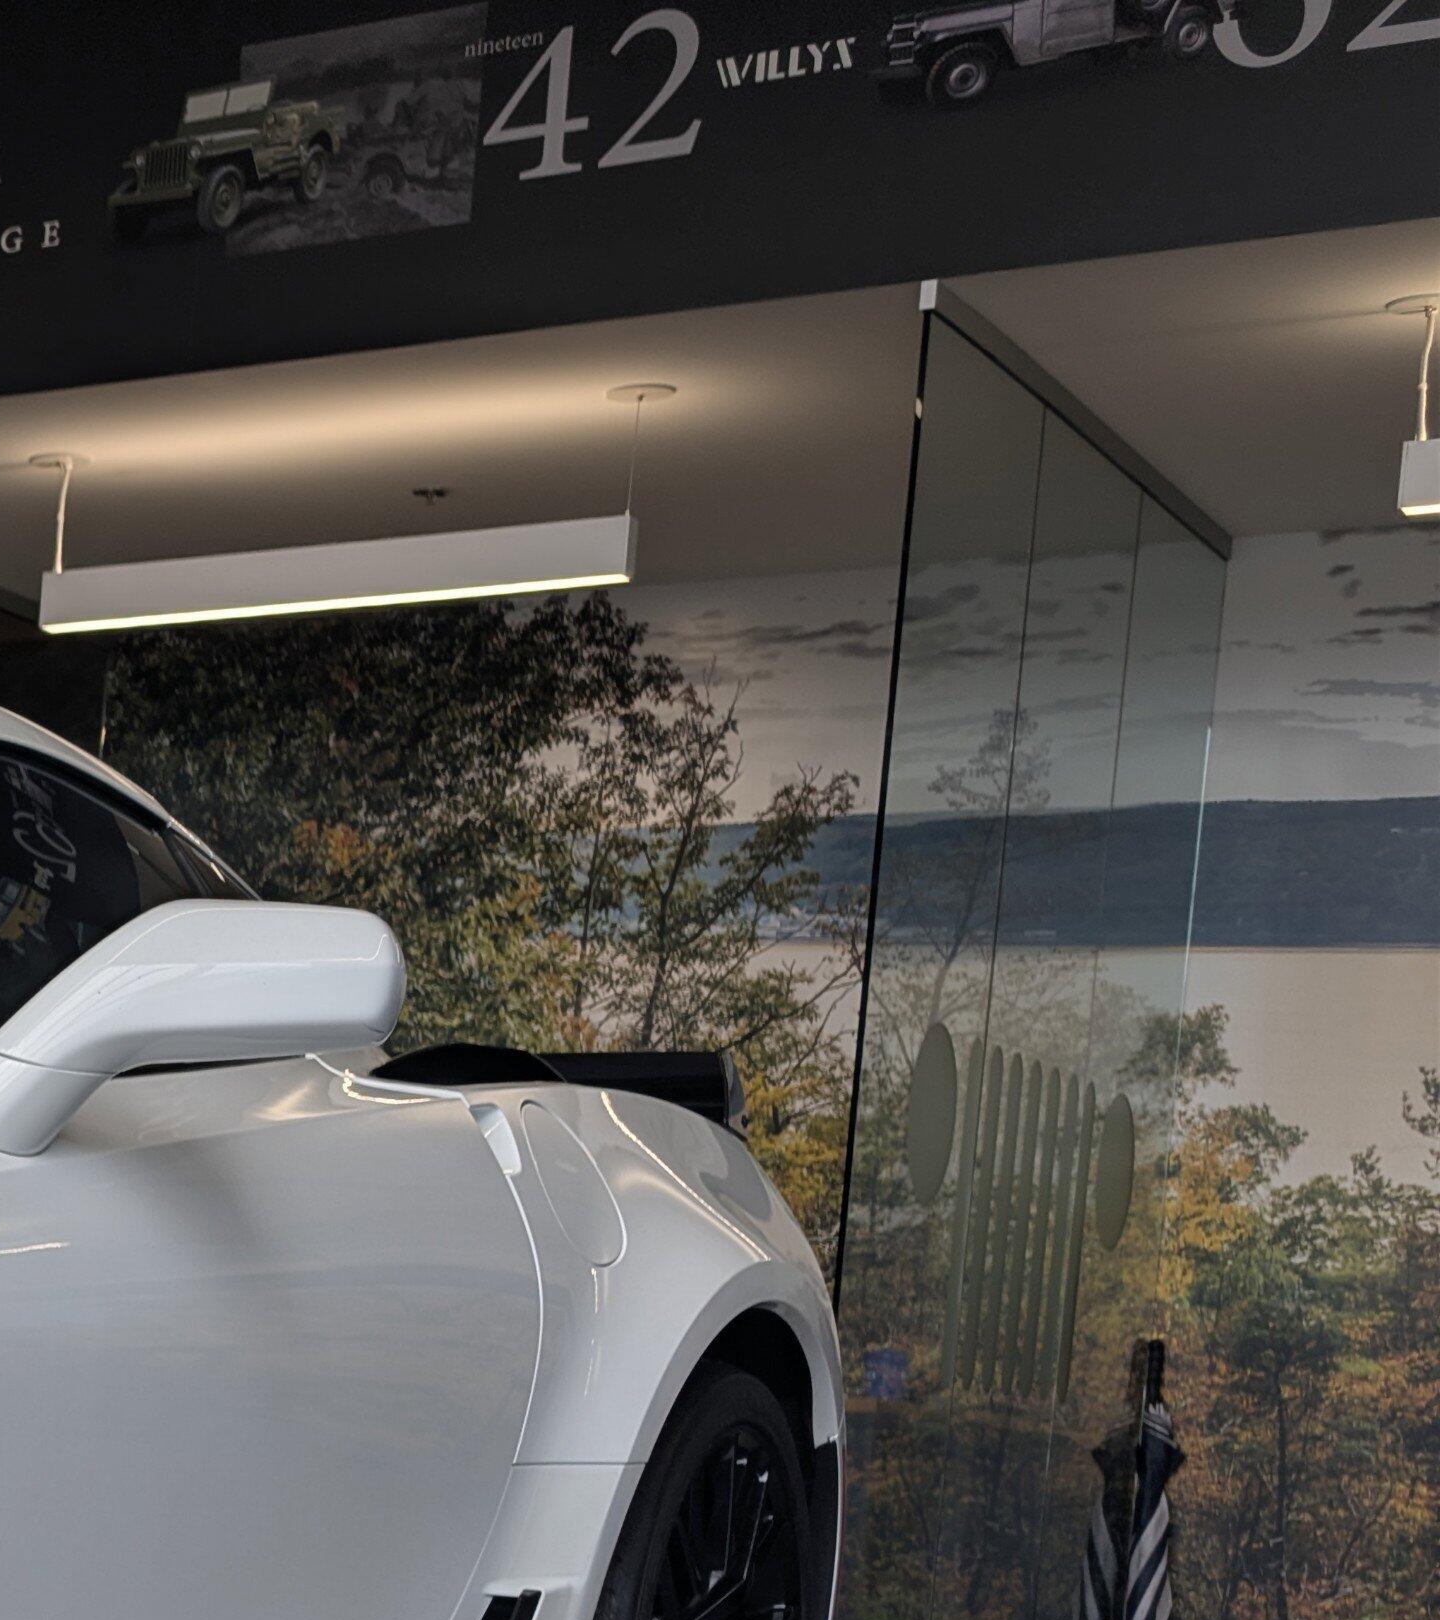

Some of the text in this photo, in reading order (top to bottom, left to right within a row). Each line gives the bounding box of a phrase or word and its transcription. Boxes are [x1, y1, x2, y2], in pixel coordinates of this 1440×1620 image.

[464, 30, 544, 59] nineteen
[716, 36, 857, 89] WILLYS
[482, 8, 702, 181] 42
